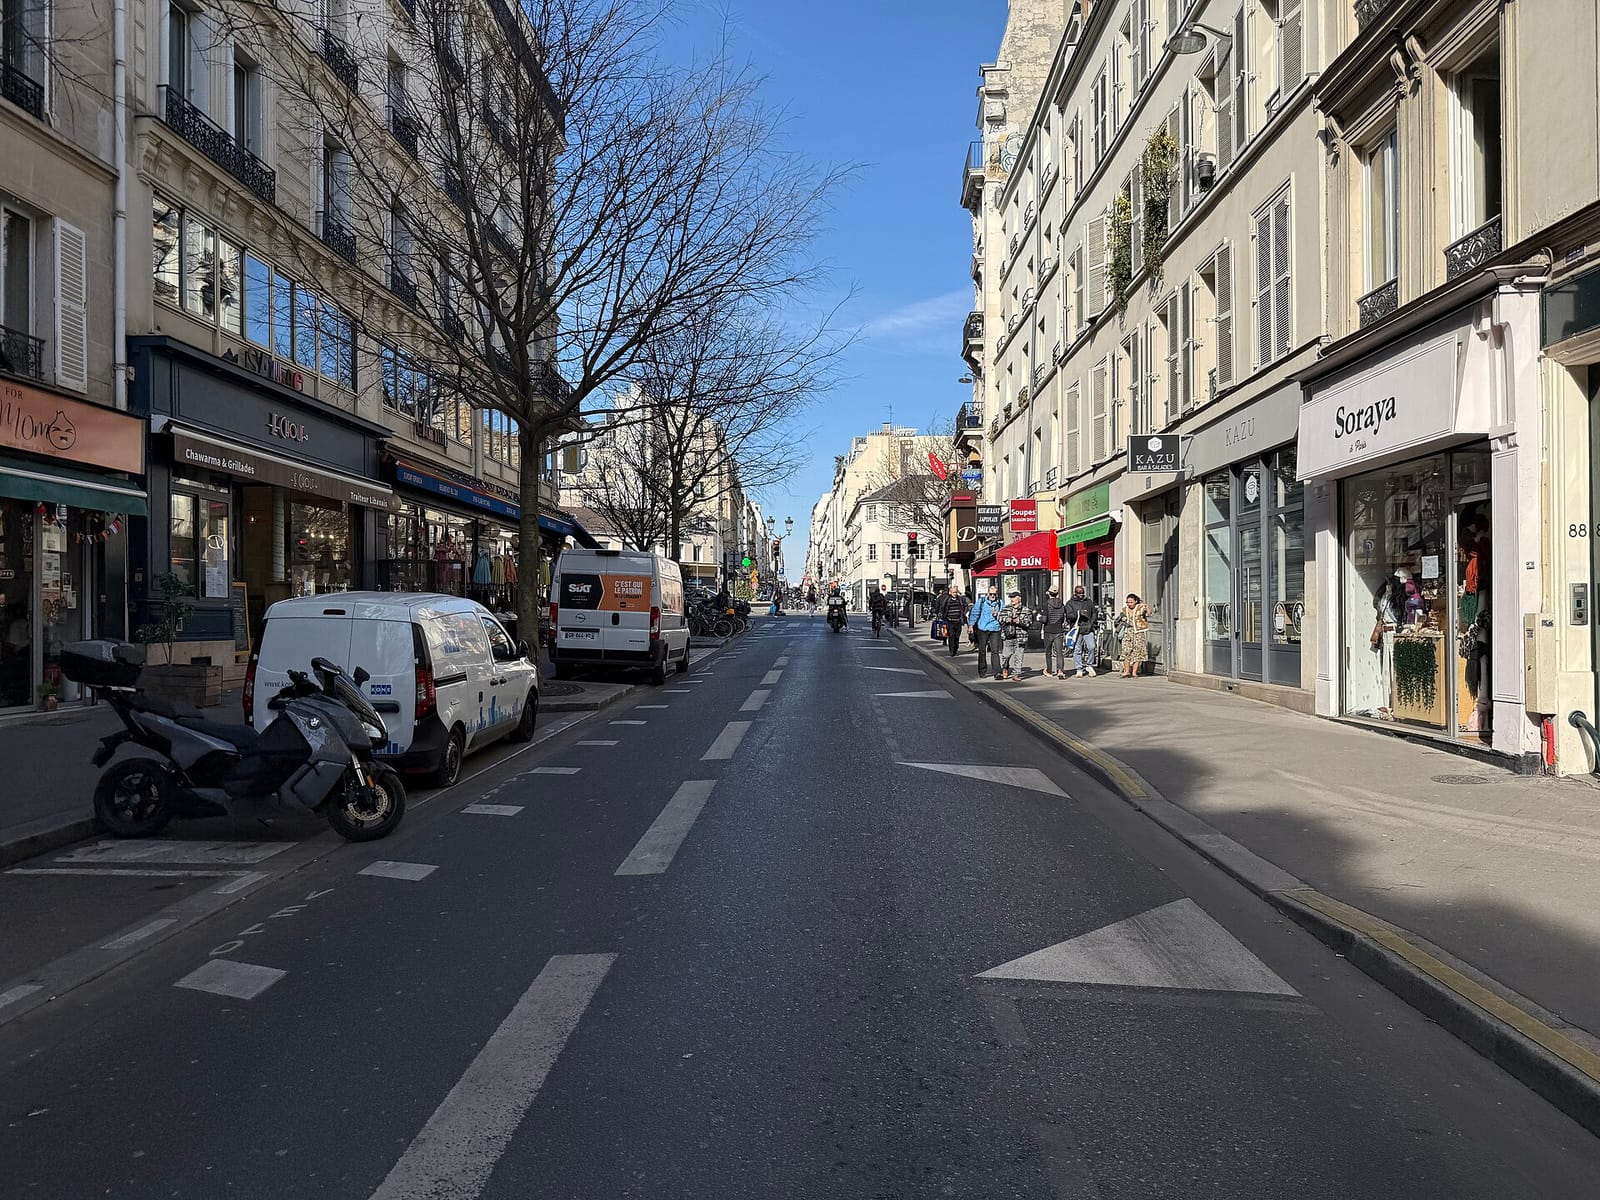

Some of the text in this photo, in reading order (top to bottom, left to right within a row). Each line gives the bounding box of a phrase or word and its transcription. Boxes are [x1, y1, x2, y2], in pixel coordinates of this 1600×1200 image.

[5, 386, 23, 400] FOR
[1334, 395, 1397, 439] Soraya
[1225, 417, 1256, 447] KAZU
[185, 448, 255, 475] Chawarma & Grillades
[1136, 453, 1175, 464] KAZU
[350, 491, 388, 507] Traiteur Libanais
[1011, 508, 1035, 516] Soupes
[1569, 523, 1587, 537] 88
[1021, 555, 1042, 566] BÚN
[371, 686, 391, 694] KONE
